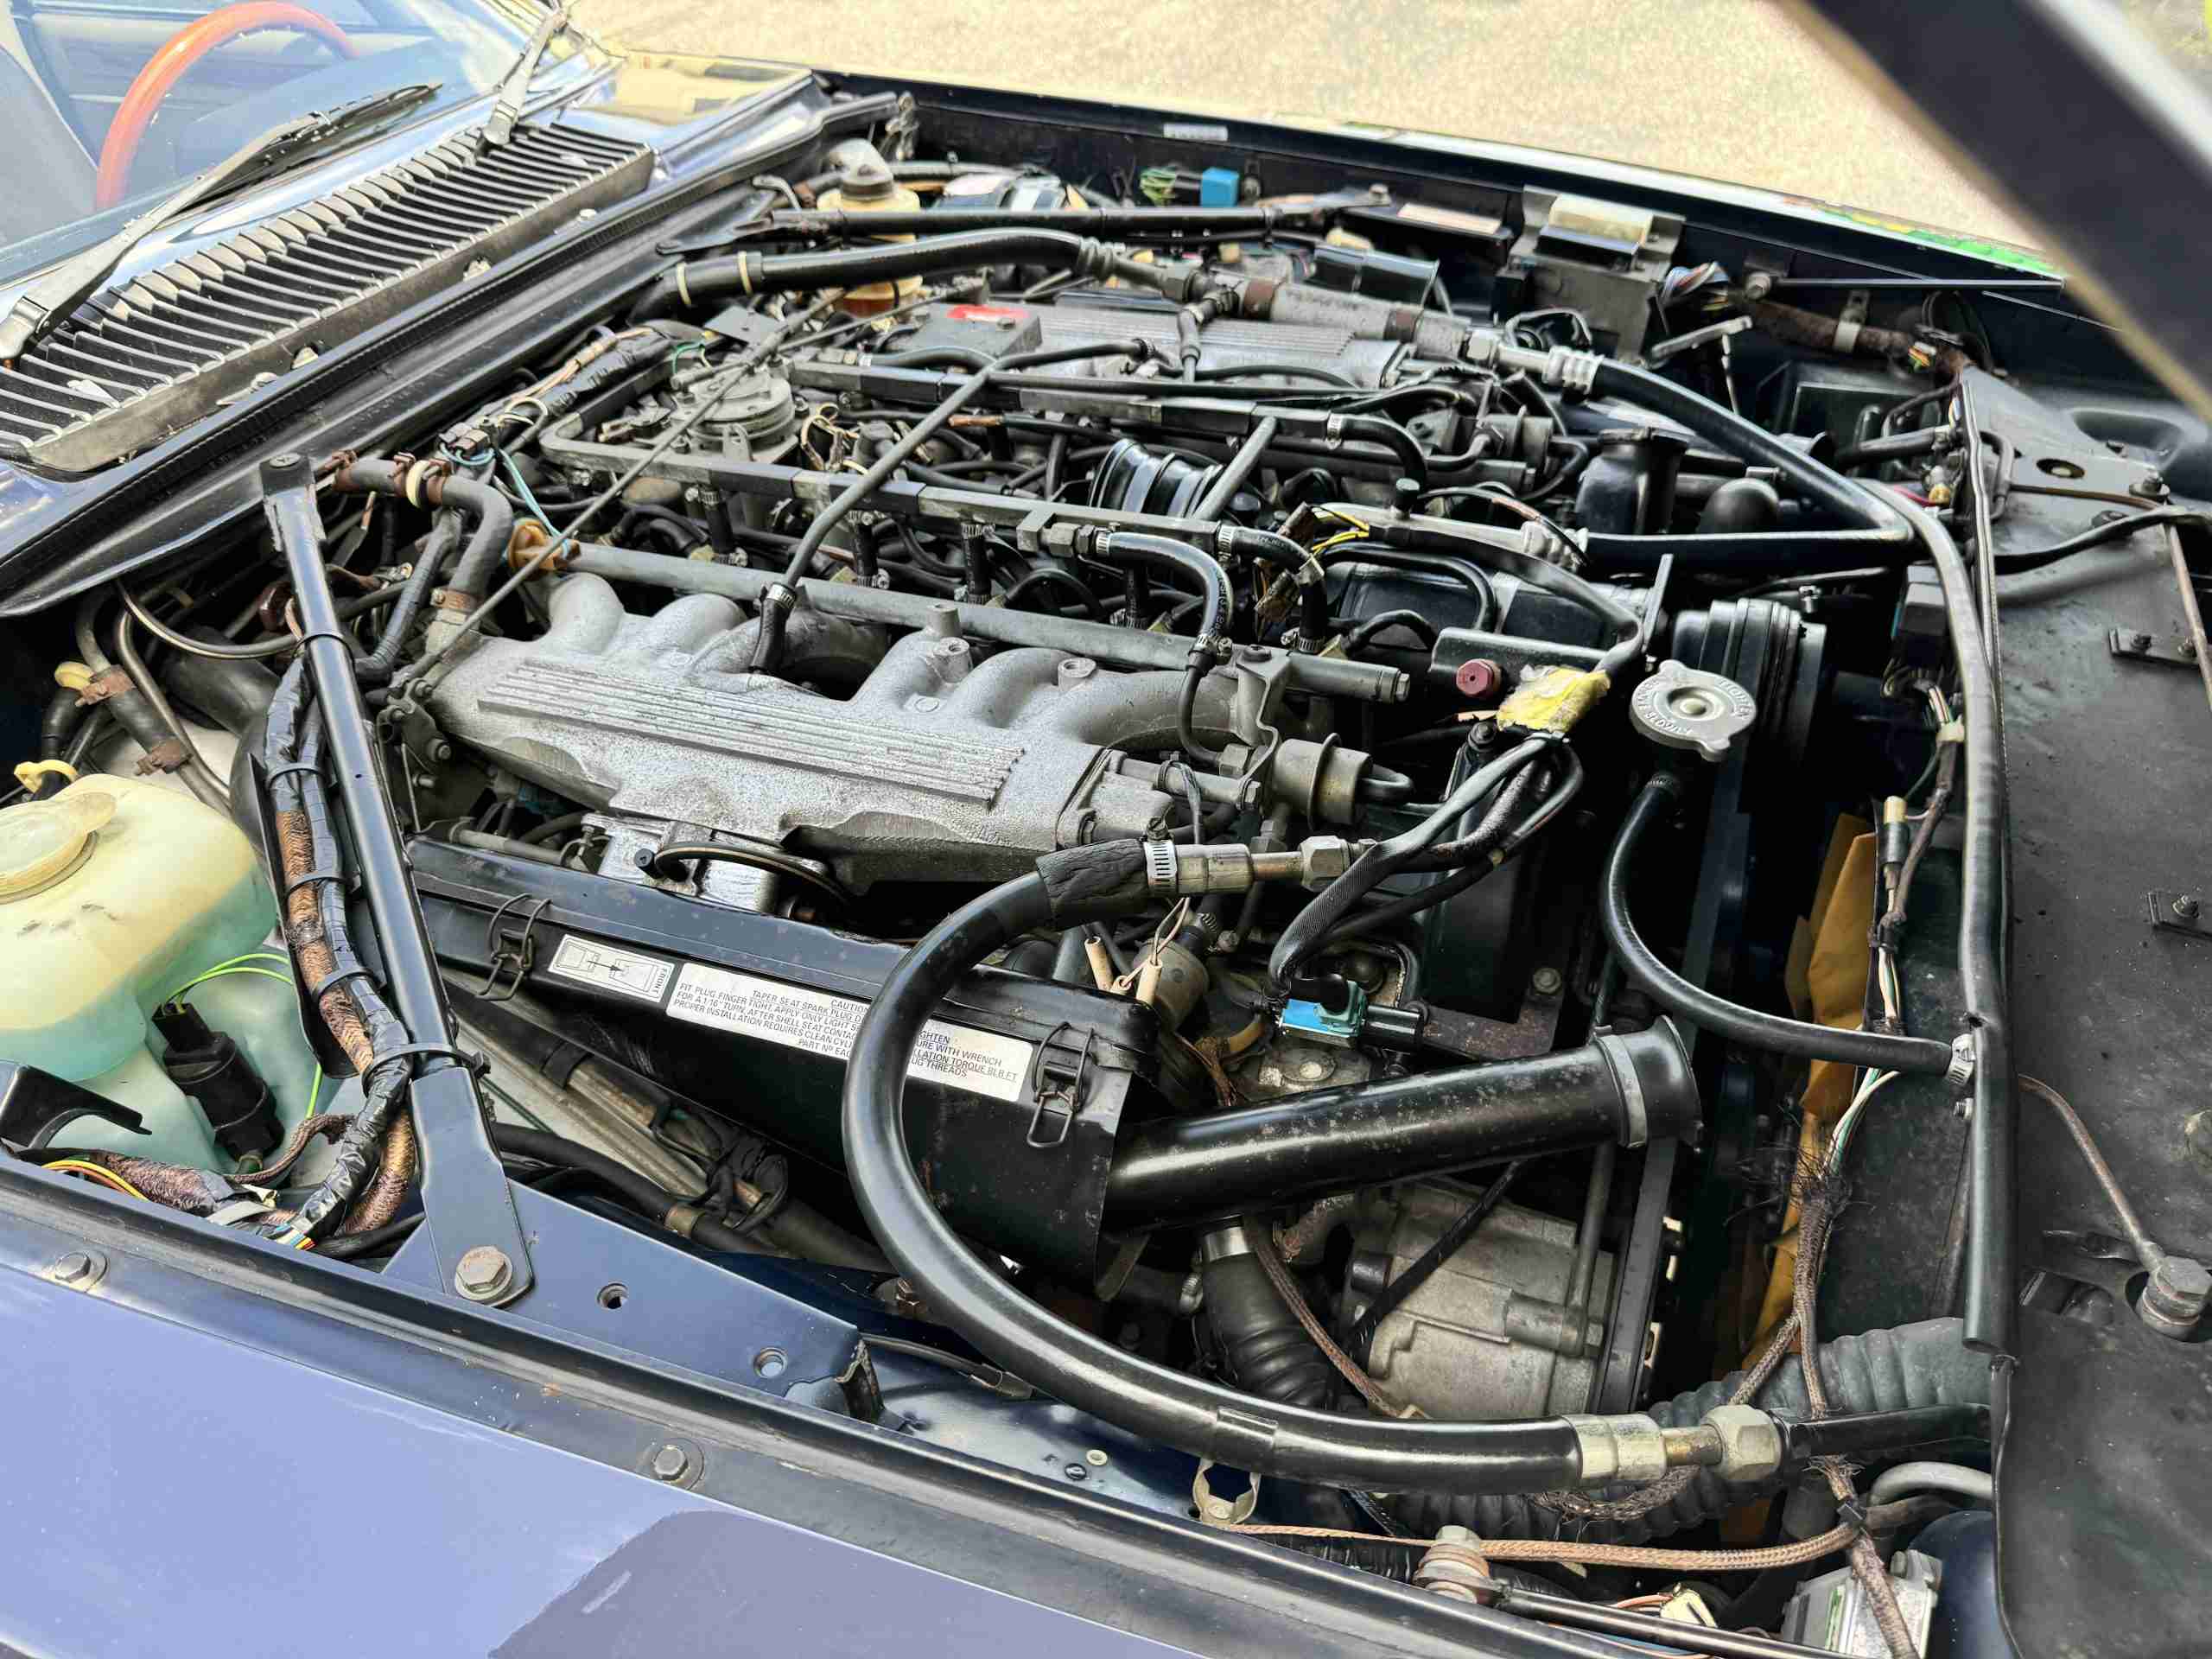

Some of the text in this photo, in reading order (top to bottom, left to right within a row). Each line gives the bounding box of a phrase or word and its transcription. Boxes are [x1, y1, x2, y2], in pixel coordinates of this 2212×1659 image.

[672, 999, 705, 1013] PROPER
[704, 1007, 763, 1027] INSTALLATION
[762, 1020, 804, 1036] REQUIRES
[804, 1031, 833, 1044] CLEAN
[694, 987, 716, 997] PLUG
[717, 992, 747, 1005] FINGER
[773, 1006, 798, 1017] APPLY
[800, 1012, 823, 1023] ONLY
[823, 1018, 849, 1029] LIGHT
[934, 1045, 960, 1056] WITH
[960, 1051, 1002, 1066] WRENCH
[752, 990, 778, 1002] TAPER
[779, 997, 800, 1007] SEAT
[801, 1002, 830, 1014] SPARK
[829, 1009, 854, 1020] PLUG
[676, 991, 694, 1001] FOR
[747, 1008, 774, 1020] AFTER
[774, 1015, 800, 1027] SHELL
[801, 1021, 822, 1032] SEAT
[950, 1058, 984, 1071] TORQUE
[797, 1039, 819, 1049] PART
